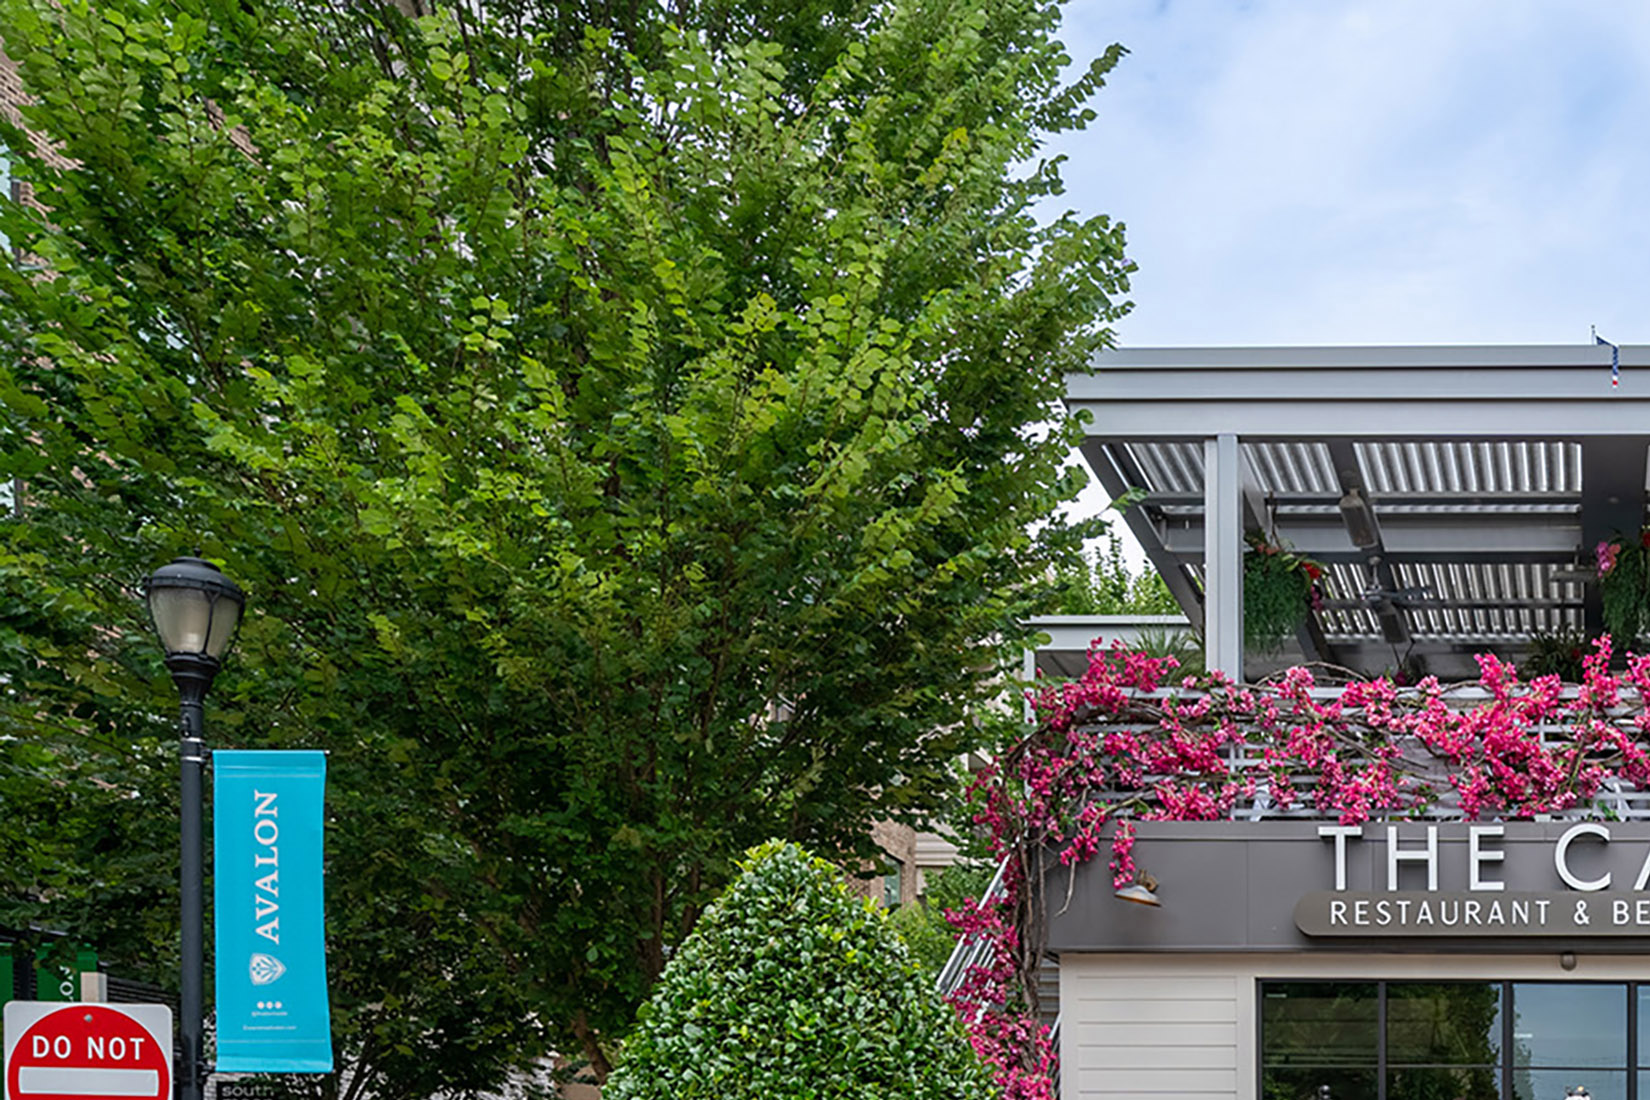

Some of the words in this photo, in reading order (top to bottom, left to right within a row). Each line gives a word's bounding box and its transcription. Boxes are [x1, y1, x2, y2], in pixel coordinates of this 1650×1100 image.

[253, 789, 280, 945] AVALON
[1317, 824, 1505, 892] THE
[1330, 899, 1551, 926] RESTAURANT
[1573, 899, 1592, 926] &
[32, 1035, 72, 1059] DO
[87, 1037, 145, 1061] NOT
